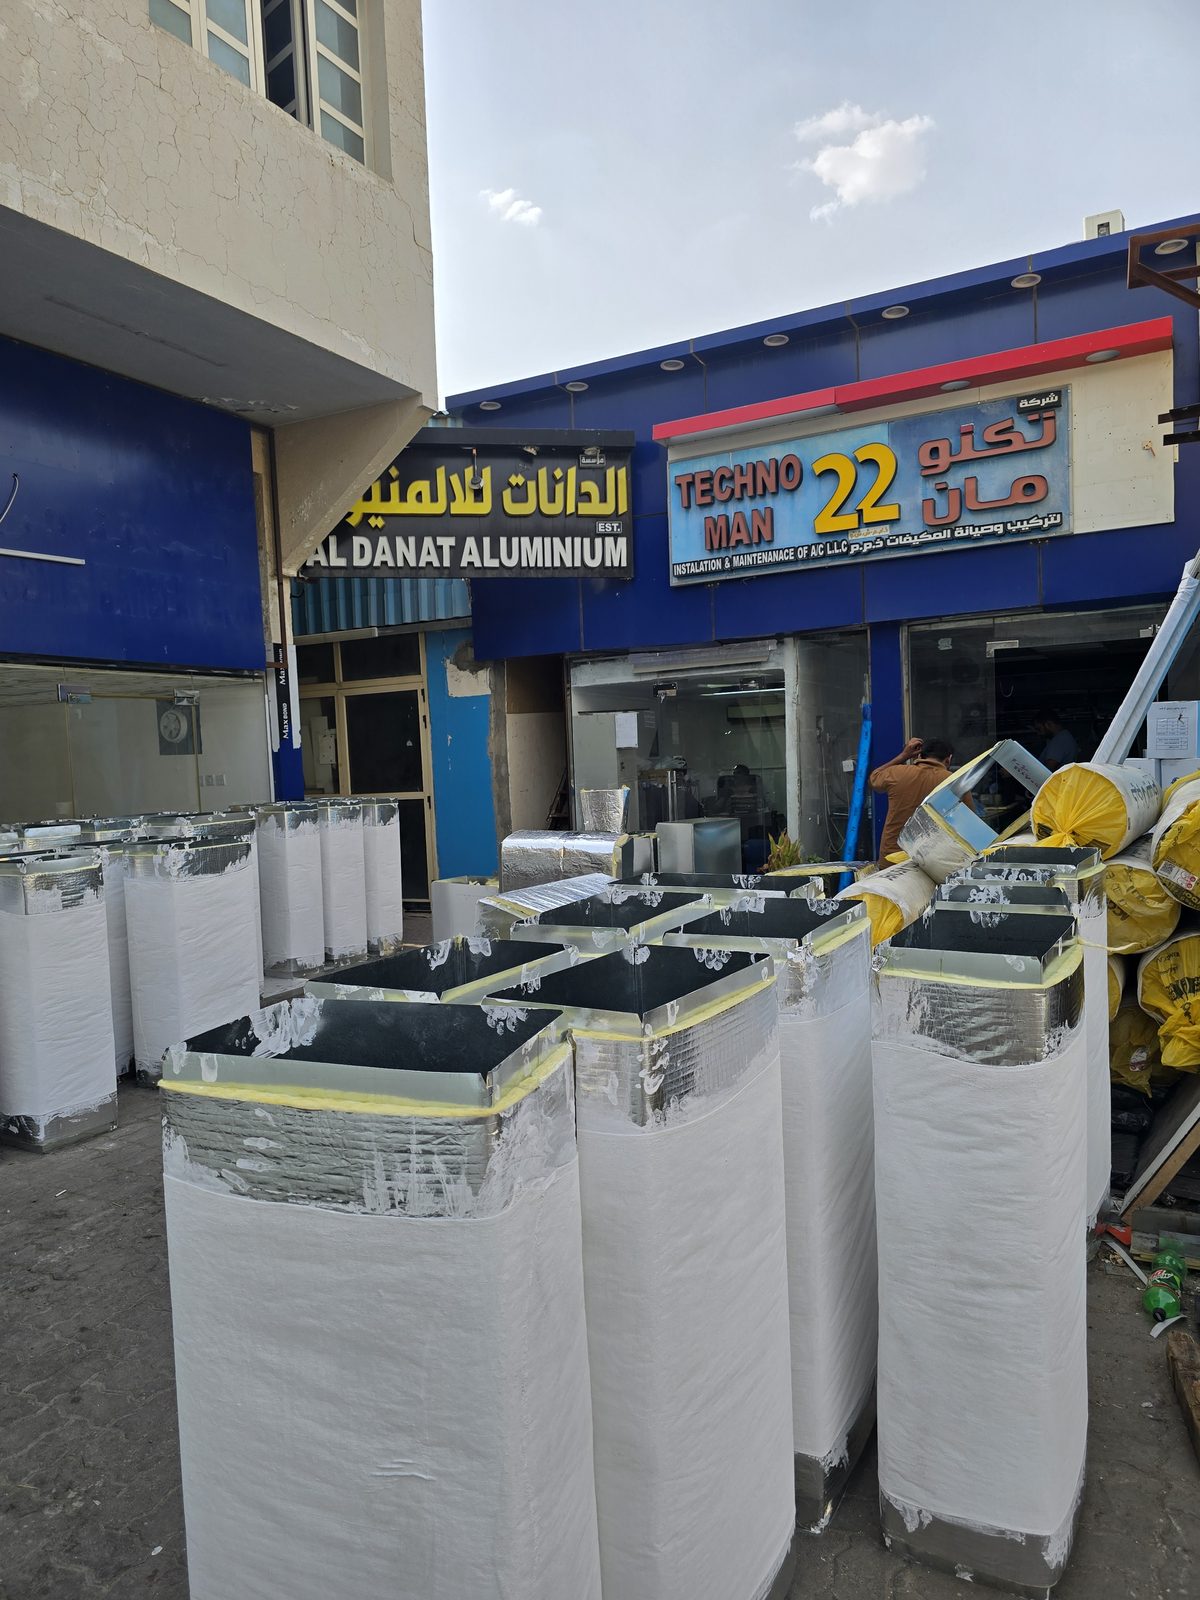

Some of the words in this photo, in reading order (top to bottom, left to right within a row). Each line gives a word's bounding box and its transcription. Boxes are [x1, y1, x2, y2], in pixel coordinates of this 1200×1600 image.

[1019, 393, 1059, 408] شركة
[918, 410, 1057, 477] تكنو
[345, 464, 493, 530] للالمنيو
[502, 466, 628, 516] الدانات
[675, 453, 802, 508] TECHNO
[811, 442, 900, 534] 22
[922, 474, 1049, 526] مان
[598, 523, 621, 533] EST.
[703, 507, 774, 552] MAN
[887, 529, 951, 546] المكيفات
[954, 524, 1004, 539] وصيانة
[1007, 513, 1061, 532] لتركيب
[306, 534, 347, 567] AL
[352, 535, 456, 568] DANAT
[460, 536, 628, 568] ALUMINIUM
[673, 559, 722, 575] INSTALATION
[724, 556, 731, 569] &
[732, 548, 795, 568] MAINTENANACE
[797, 546, 808, 559] OF
[810, 544, 824, 557] A/C
[826, 540, 848, 555] L.L.C
